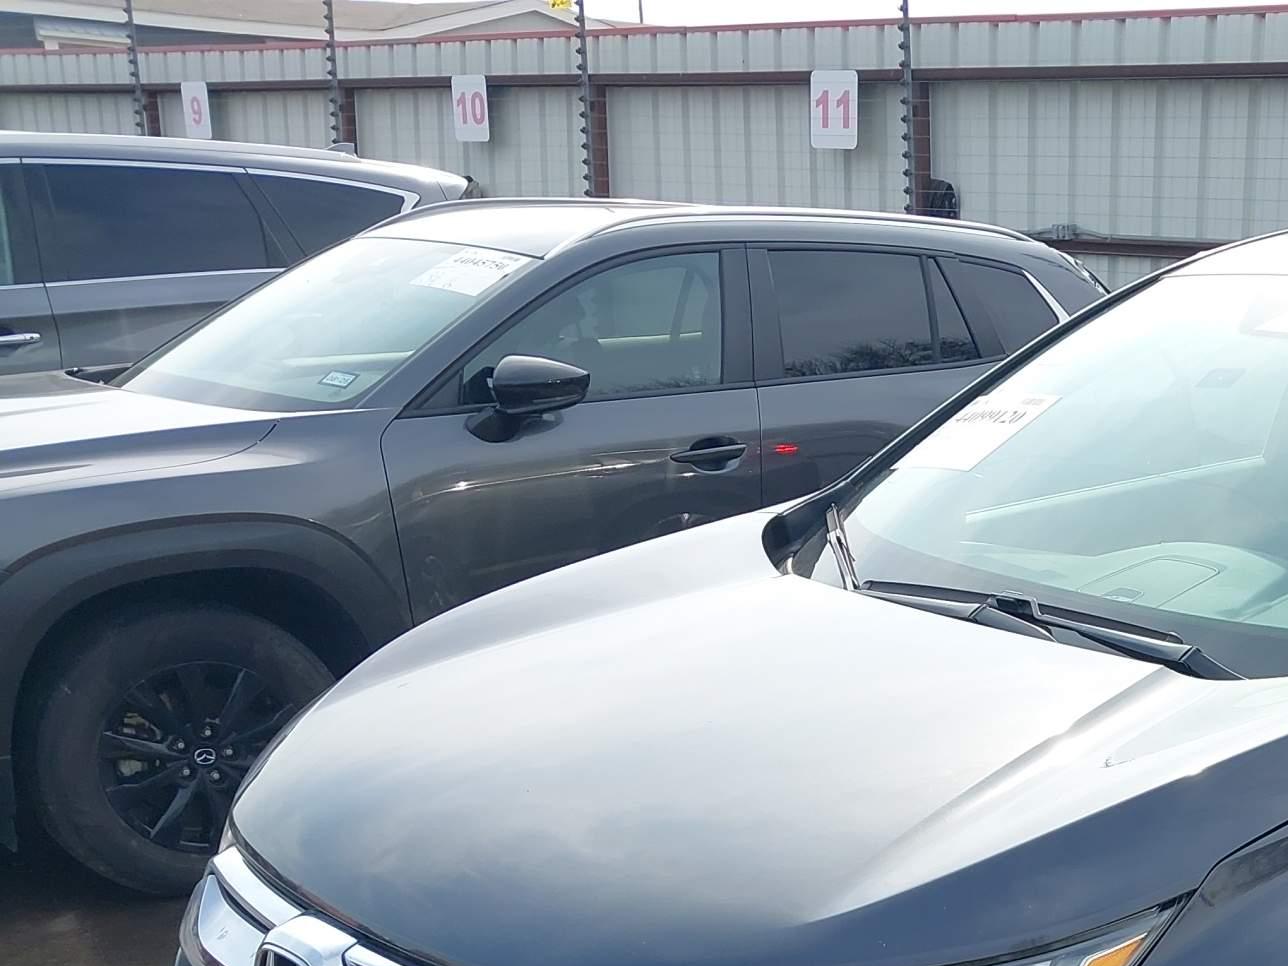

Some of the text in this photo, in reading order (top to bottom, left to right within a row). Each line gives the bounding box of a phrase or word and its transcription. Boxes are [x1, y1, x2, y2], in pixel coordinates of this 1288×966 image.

[191, 96, 202, 124] 9
[457, 91, 486, 125] 10
[816, 90, 850, 129] 11
